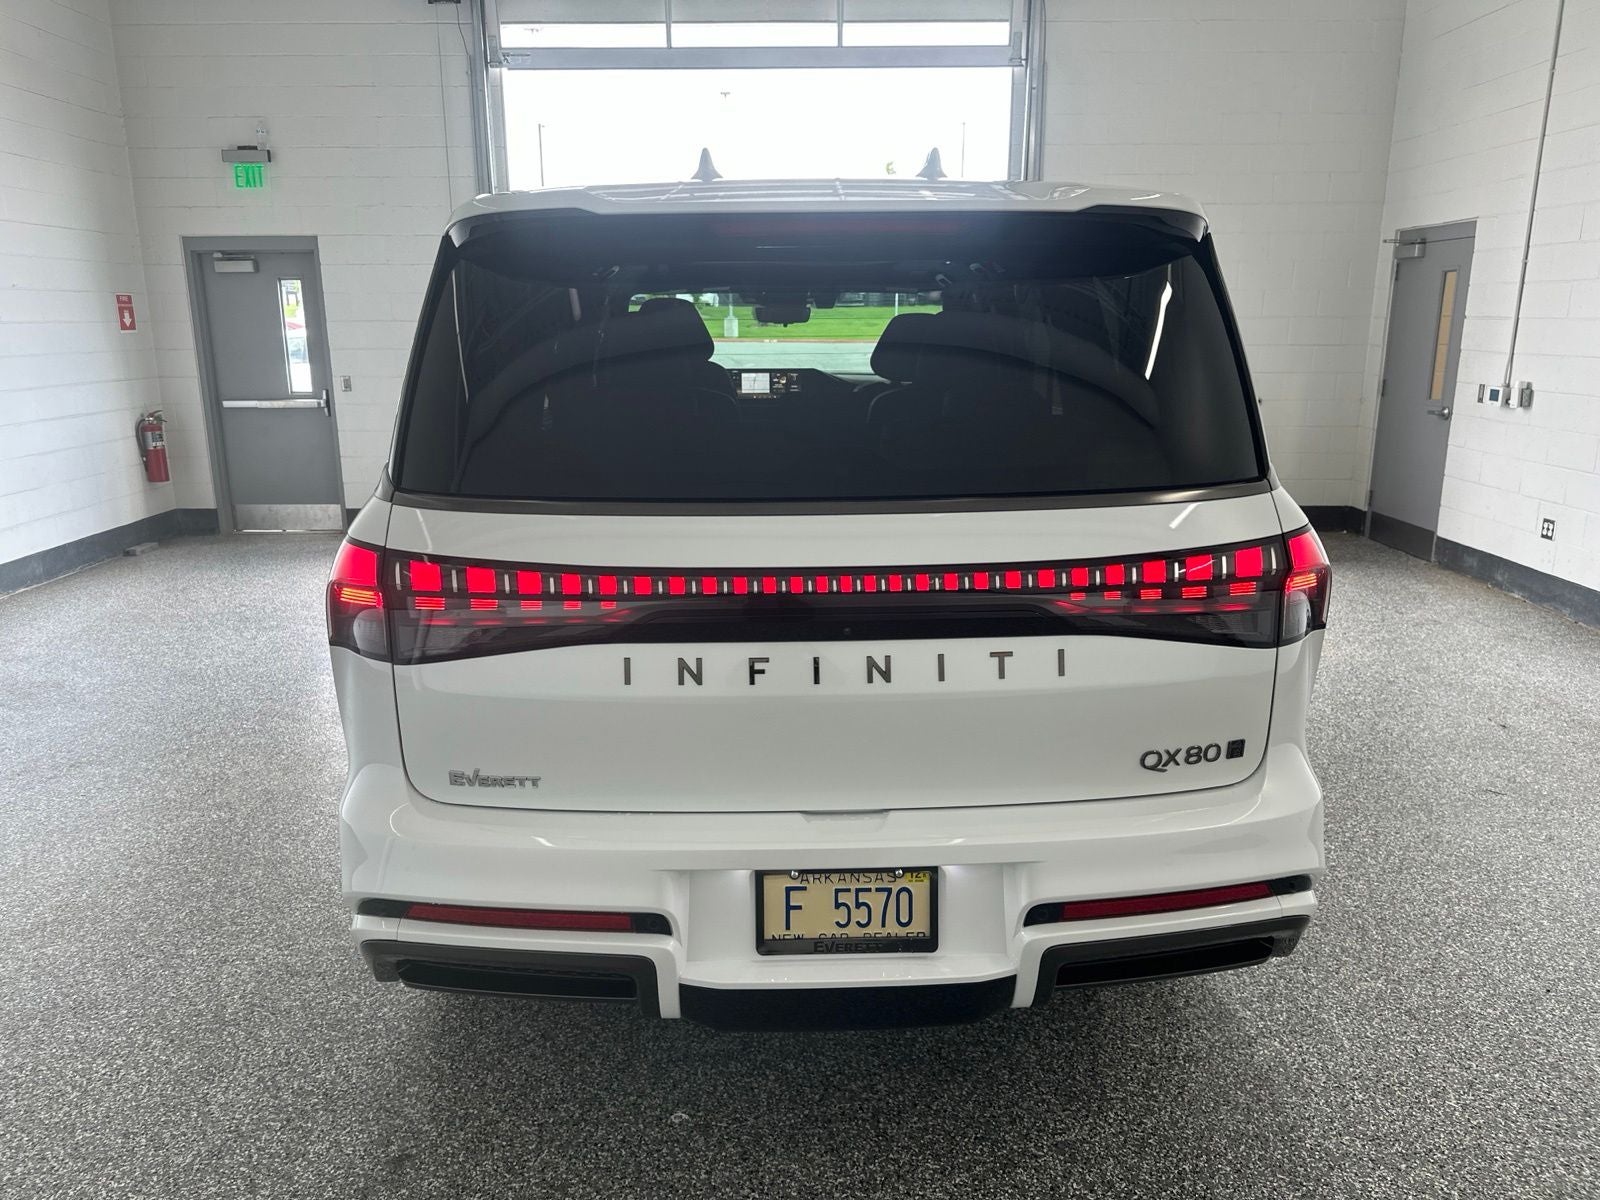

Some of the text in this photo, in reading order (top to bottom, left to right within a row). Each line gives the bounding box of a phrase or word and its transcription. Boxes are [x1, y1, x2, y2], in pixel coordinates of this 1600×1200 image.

[234, 164, 264, 188] EXIT
[623, 648, 1066, 686] INFINITI
[1139, 742, 1222, 773] QX80
[800, 872, 897, 884] ARKANSAS
[784, 886, 914, 931] F 5570
